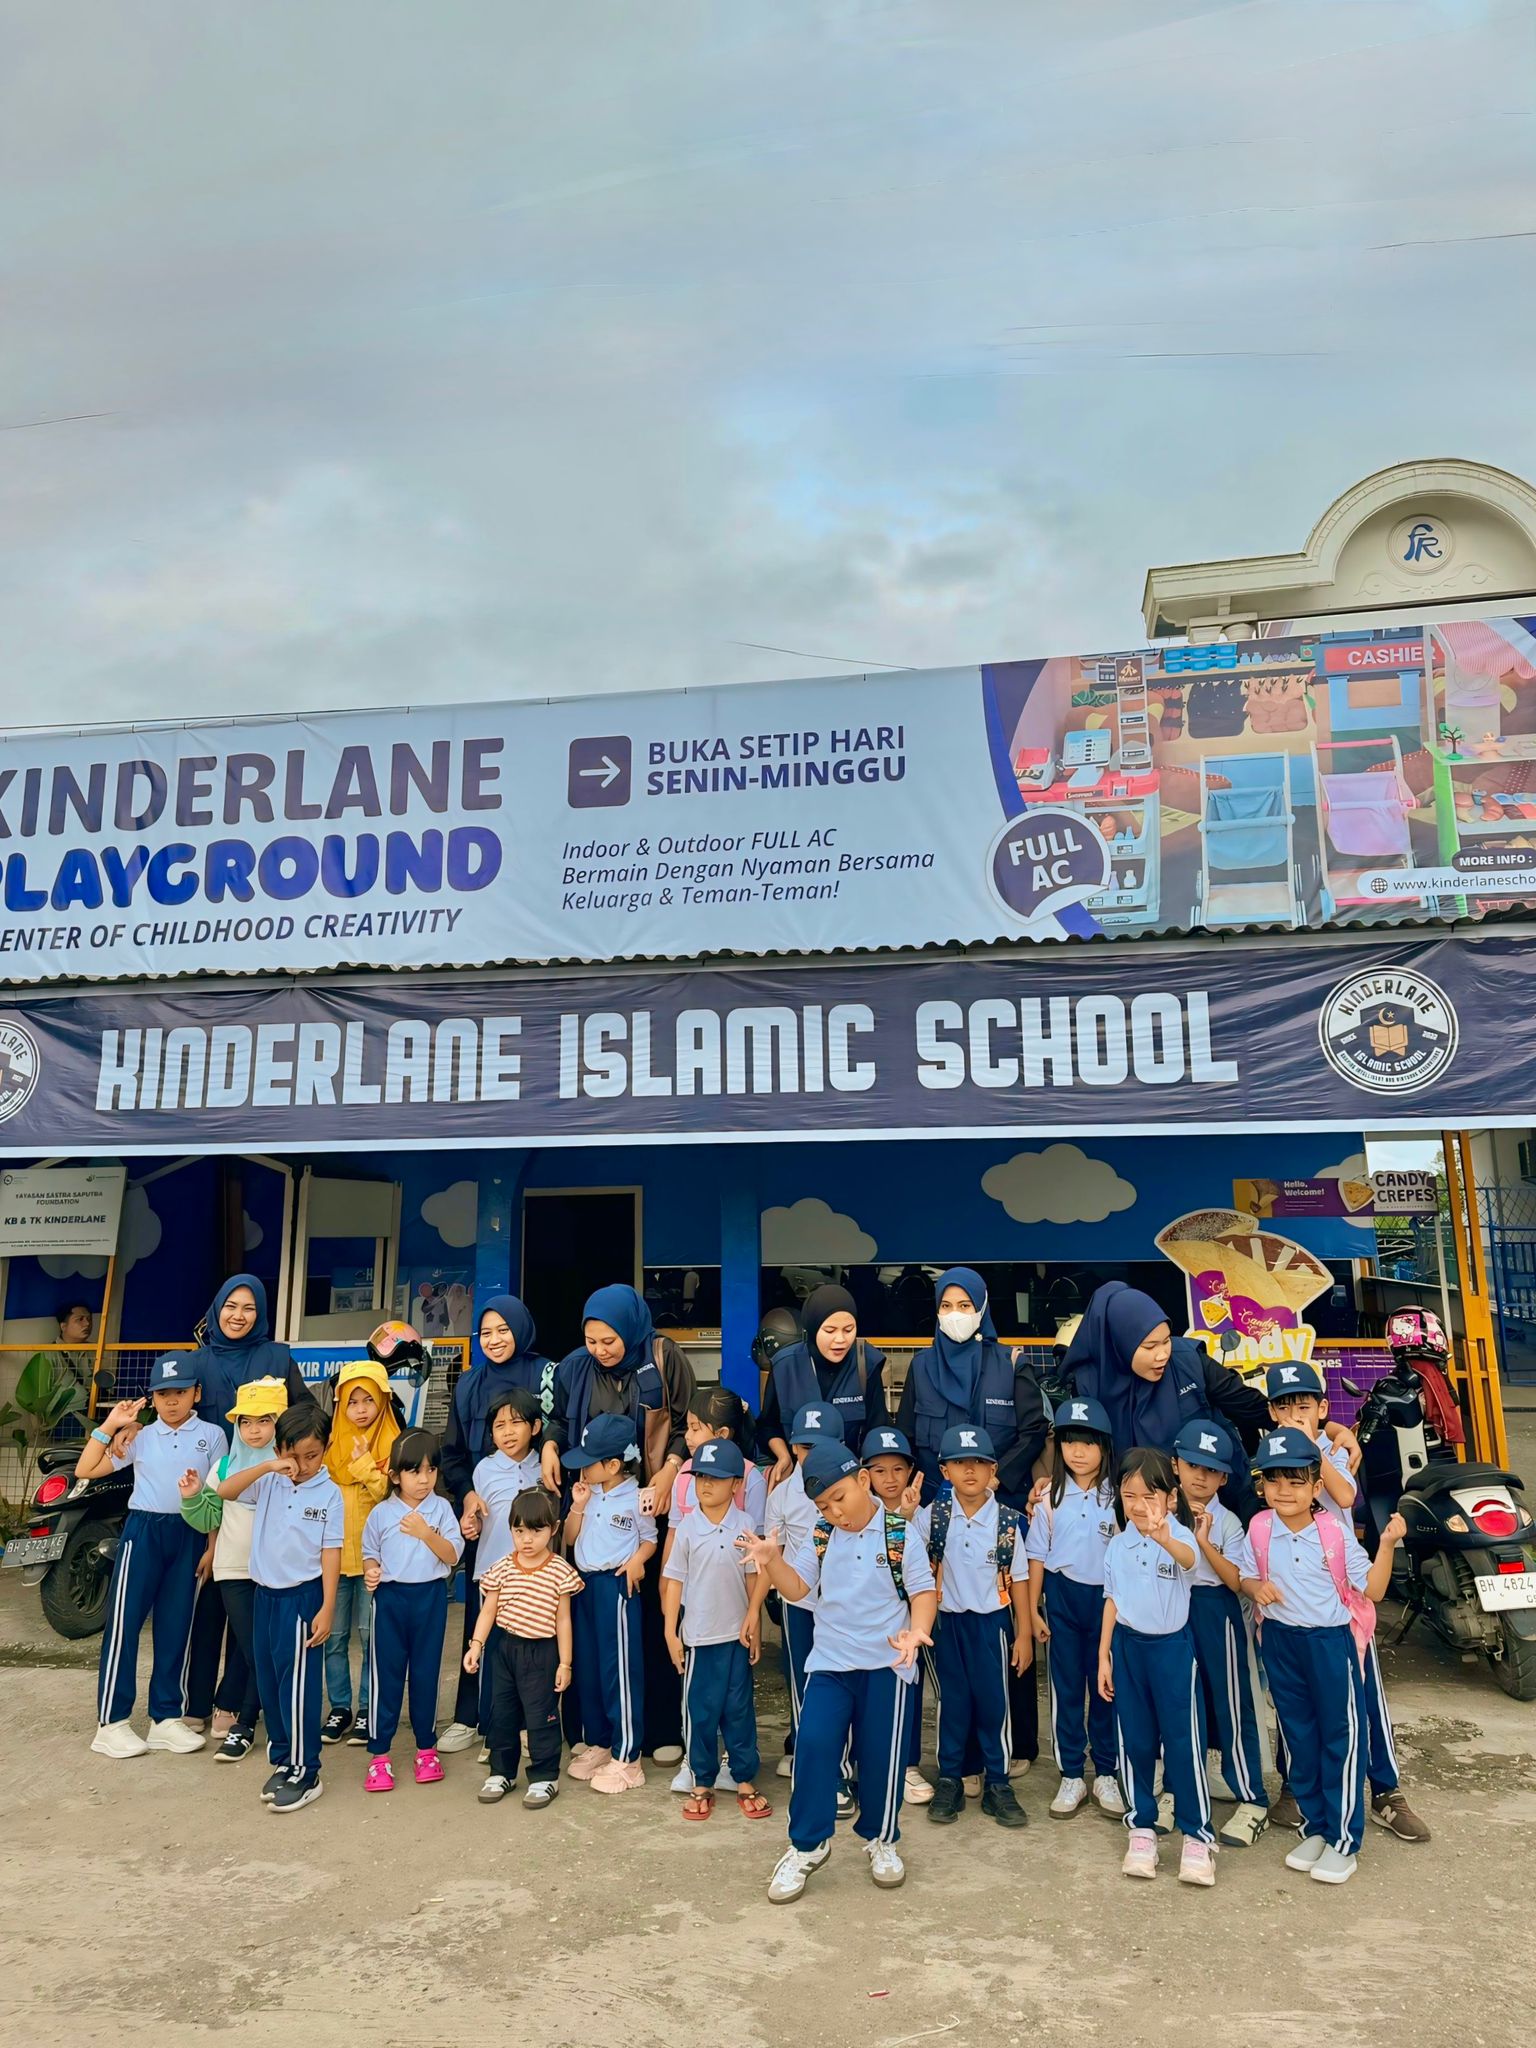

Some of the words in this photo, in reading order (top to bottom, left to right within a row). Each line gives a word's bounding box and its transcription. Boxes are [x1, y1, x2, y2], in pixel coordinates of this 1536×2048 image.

[648, 738, 730, 764] BUKA
[739, 732, 819, 761] SETIP
[830, 725, 905, 754] HARI
[647, 755, 906, 796] SENIN-MINGGU
[562, 839, 630, 859] Indoor
[635, 838, 650, 856] &
[658, 833, 745, 855] Outdoor
[751, 829, 801, 850] FULL
[807, 828, 837, 848] AC
[1008, 828, 1083, 866] FULL
[0, 826, 502, 911] LAYGROUND
[562, 863, 648, 884] Bermain
[655, 860, 733, 883] Dengan
[741, 857, 830, 881] Nyaman
[838, 852, 935, 872] Bersama
[1459, 855, 1494, 866] MORE
[1497, 854, 1526, 865] INFO
[1032, 860, 1073, 892] AC
[562, 889, 653, 912] Keluarga
[659, 887, 675, 906] &
[682, 880, 840, 906] Teman-Teman!
[0, 926, 82, 952] ENTER
[89, 923, 124, 948] OF
[132, 916, 294, 946] CHILDHOOD
[304, 908, 463, 938] CREATIVITY
[1338, 979, 1437, 1016] KINDERLANE
[96, 1016, 522, 1110] KINDERLANE
[559, 1004, 877, 1099] ISLAMIC
[916, 991, 1239, 1091] SCHOOL
[1354, 1050, 1391, 1072] ISLAMIC
[1394, 1050, 1427, 1072] SCHOOL
[1375, 1172, 1427, 1187] CANDY
[1377, 1189, 1434, 1203] CREPES
[4, 1217, 18, 1225] KB
[30, 1217, 42, 1225] TK
[44, 1215, 107, 1224] KINDERLANE
[162, 1361, 177, 1377] K
[1280, 1367, 1300, 1383] K
[805, 1410, 821, 1428] K
[1071, 1403, 1089, 1421] K
[880, 1432, 899, 1448] K
[959, 1431, 978, 1448] K
[1199, 1432, 1218, 1453] K
[1268, 1436, 1287, 1456] K
[700, 1445, 718, 1462] K
[1479, 1578, 1496, 1592] BH
[1503, 1577, 1534, 1591] 4824
